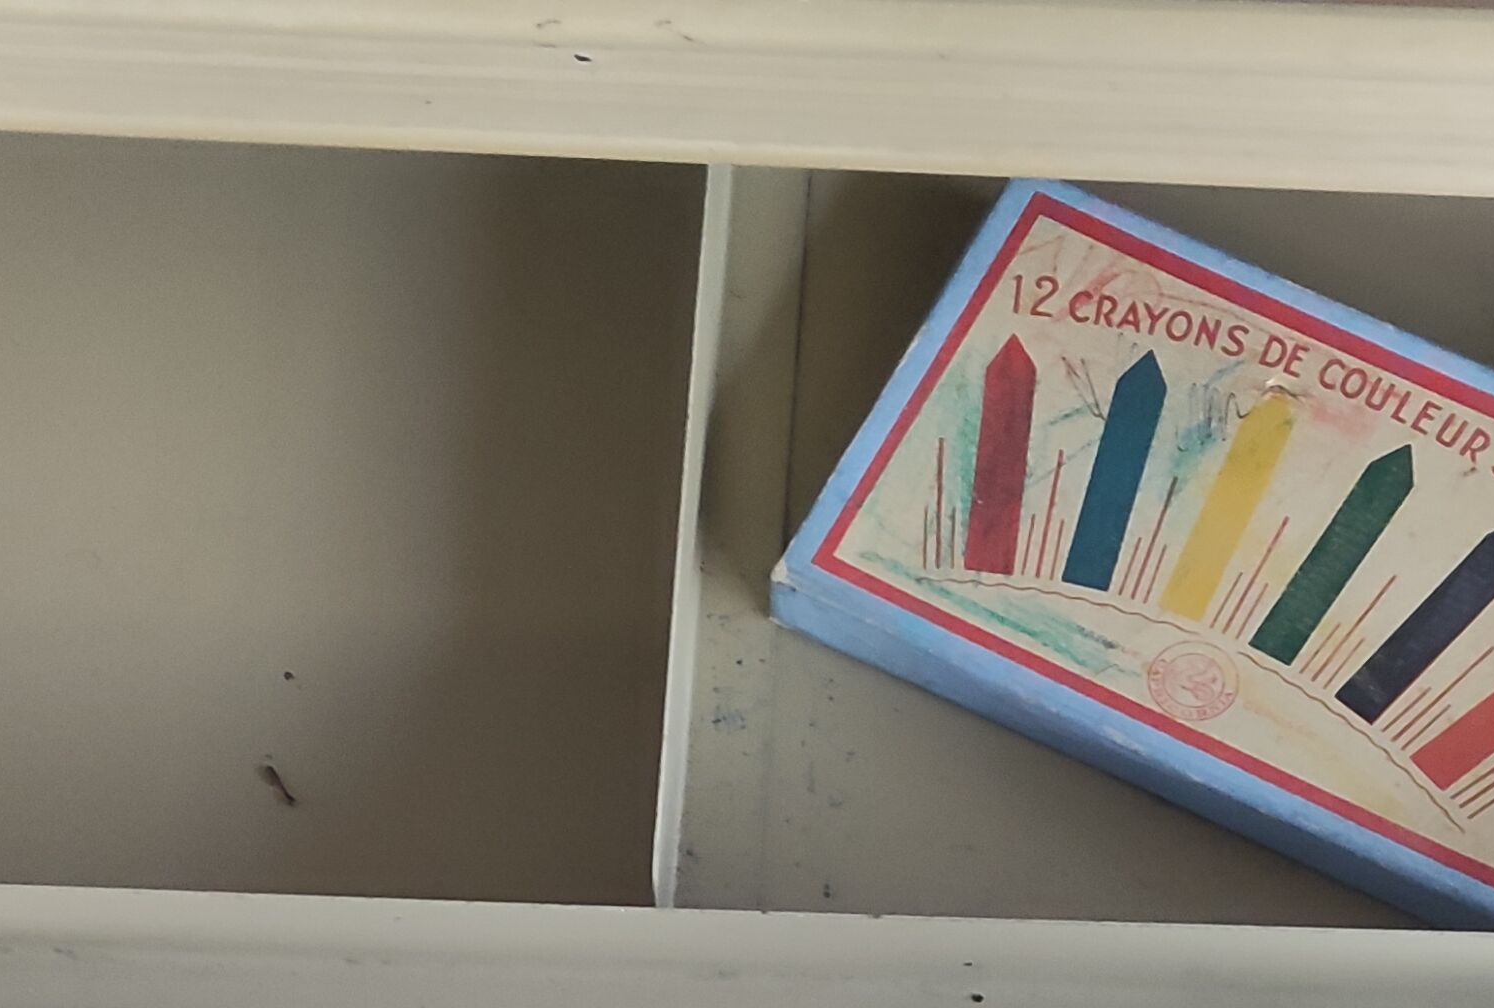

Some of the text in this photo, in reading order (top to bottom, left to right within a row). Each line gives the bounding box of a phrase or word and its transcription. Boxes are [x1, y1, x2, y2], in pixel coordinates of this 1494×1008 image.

[1011, 274, 1060, 318] 12
[1067, 290, 1250, 357] CRAYONS
[1258, 334, 1310, 379] DE
[1318, 357, 1492, 462] COULEUR
